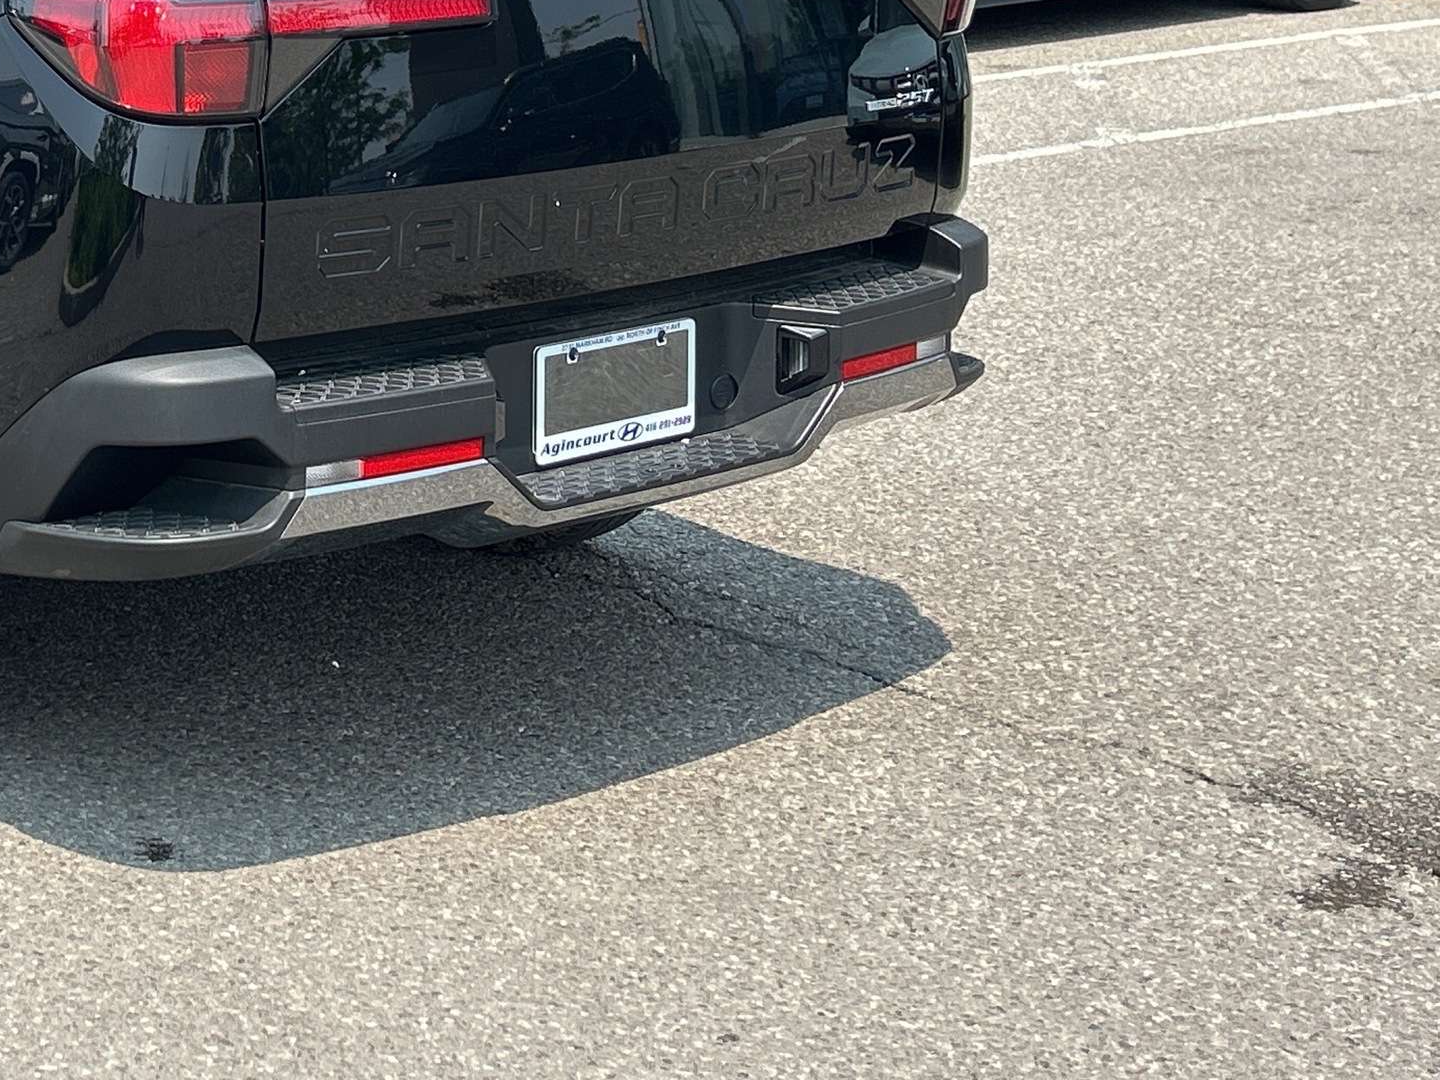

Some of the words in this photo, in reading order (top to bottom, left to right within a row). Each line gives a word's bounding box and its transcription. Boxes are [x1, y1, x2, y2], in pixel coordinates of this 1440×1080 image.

[315, 176, 680, 279] SANTA
[701, 133, 917, 220] CRUZ
[541, 428, 615, 456] Agincourt
